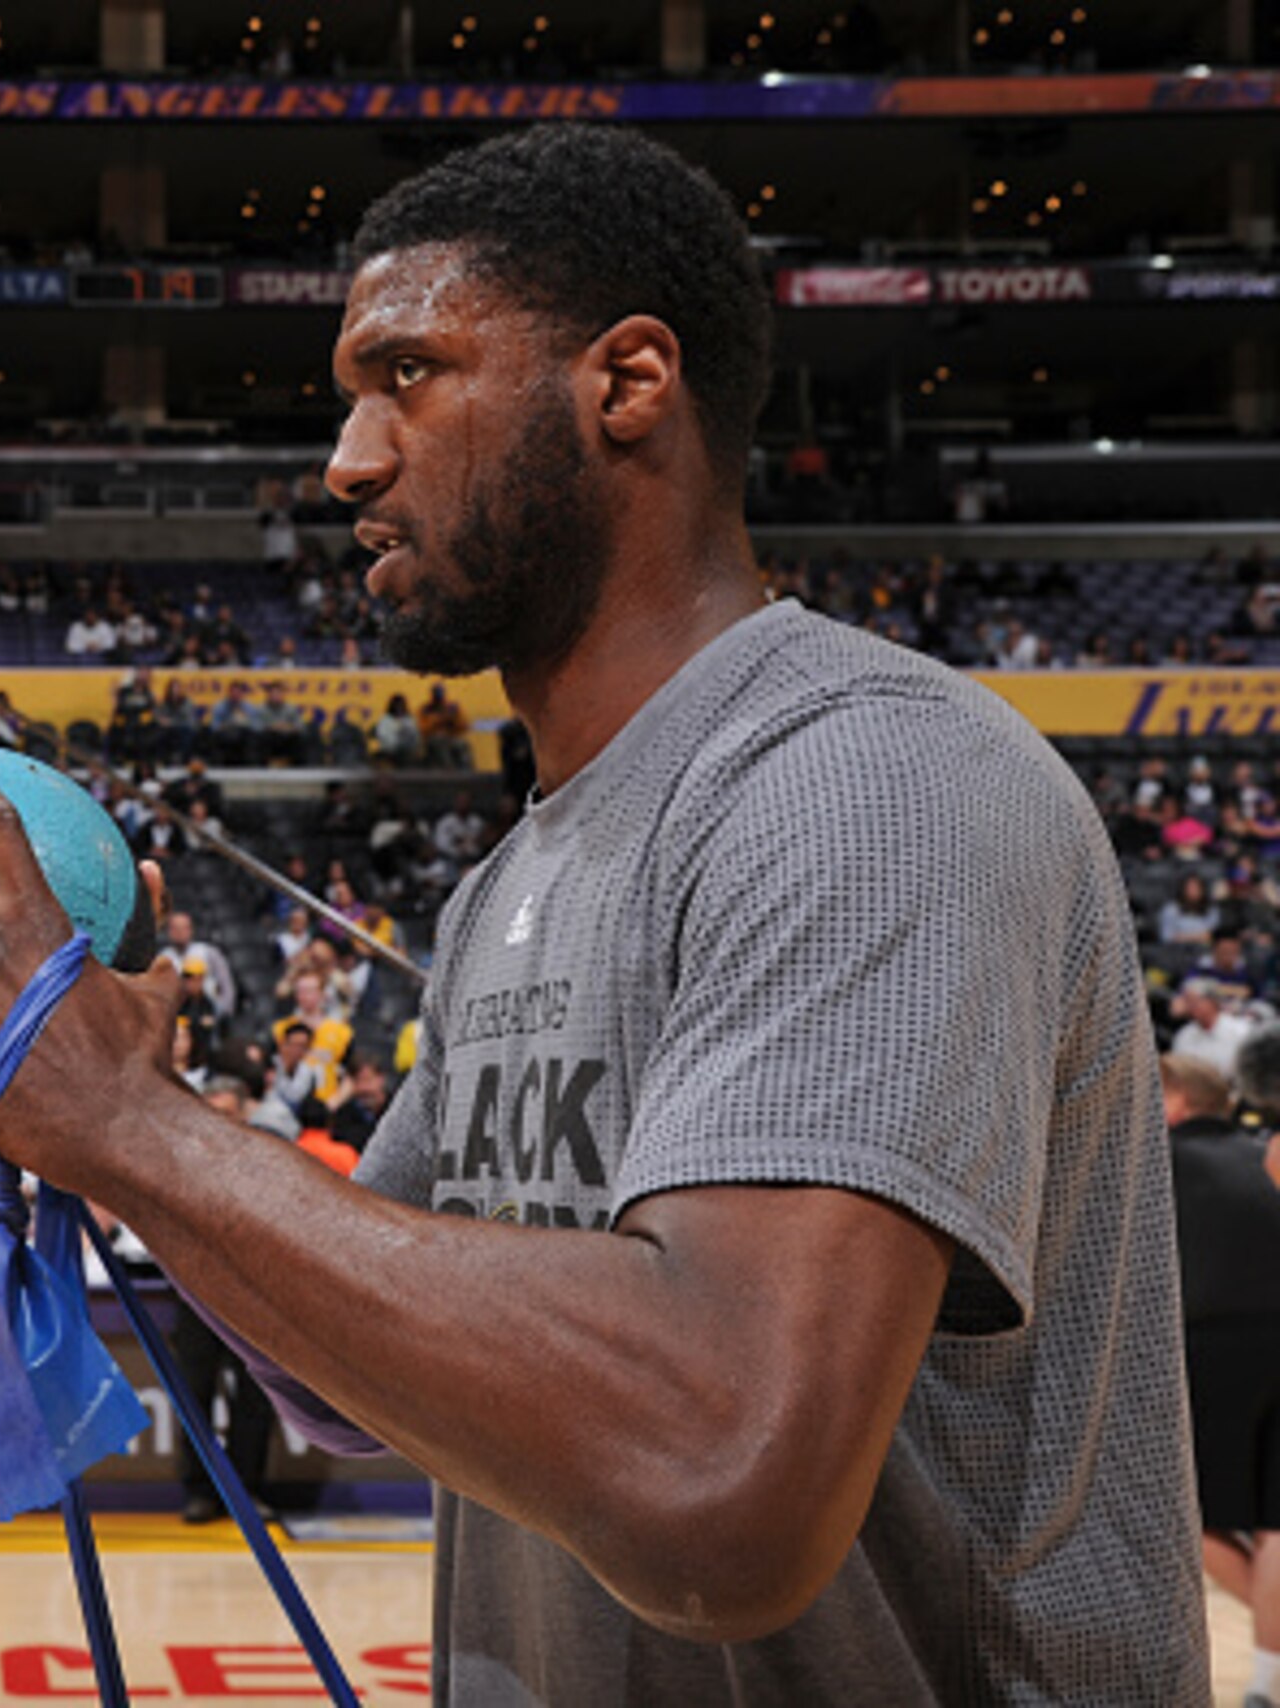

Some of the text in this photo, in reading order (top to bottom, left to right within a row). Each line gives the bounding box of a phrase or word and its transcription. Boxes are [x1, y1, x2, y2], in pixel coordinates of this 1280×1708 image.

[70, 82, 351, 117] ANGELES
[364, 83, 626, 118] LAKERS
[938, 271, 1089, 301] TOYOTA
